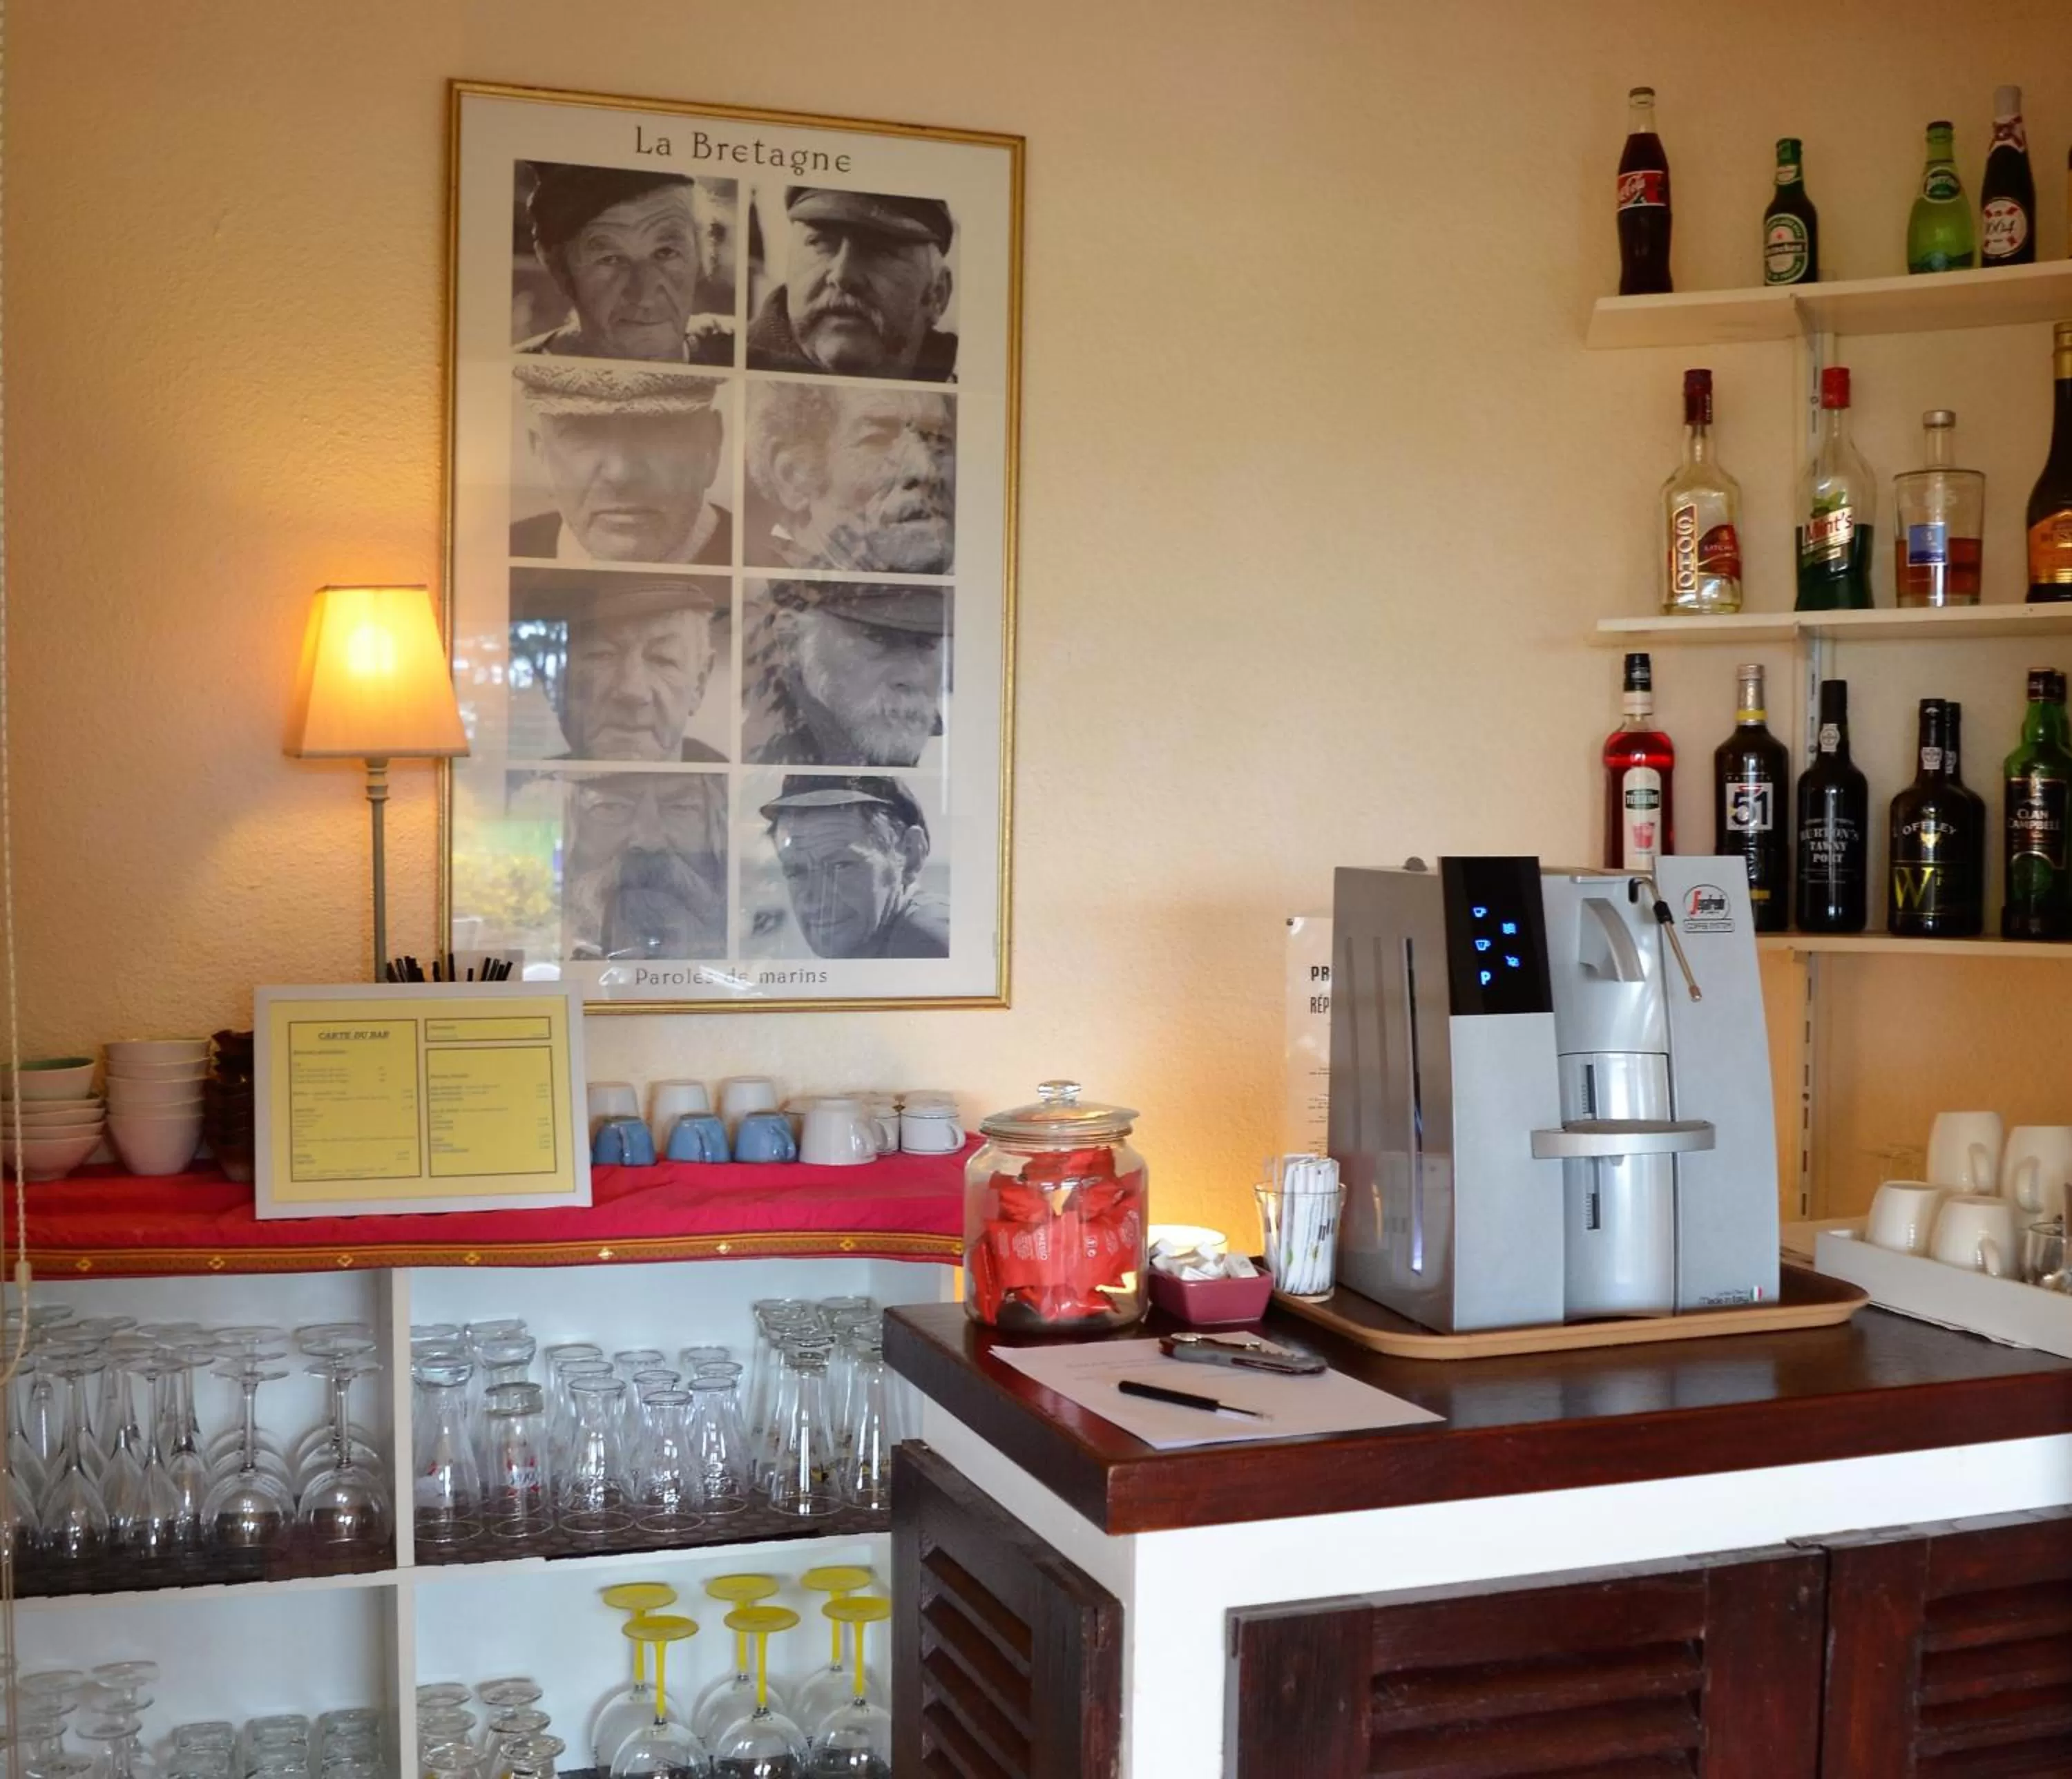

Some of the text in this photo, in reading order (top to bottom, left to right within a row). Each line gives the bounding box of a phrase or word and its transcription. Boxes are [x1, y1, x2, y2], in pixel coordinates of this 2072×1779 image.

[635, 125, 852, 175] La Bretagne
[1676, 516, 1695, 588] SOHO
[1732, 791, 1769, 825] 51
[635, 968, 828, 985] Paroles de marins
